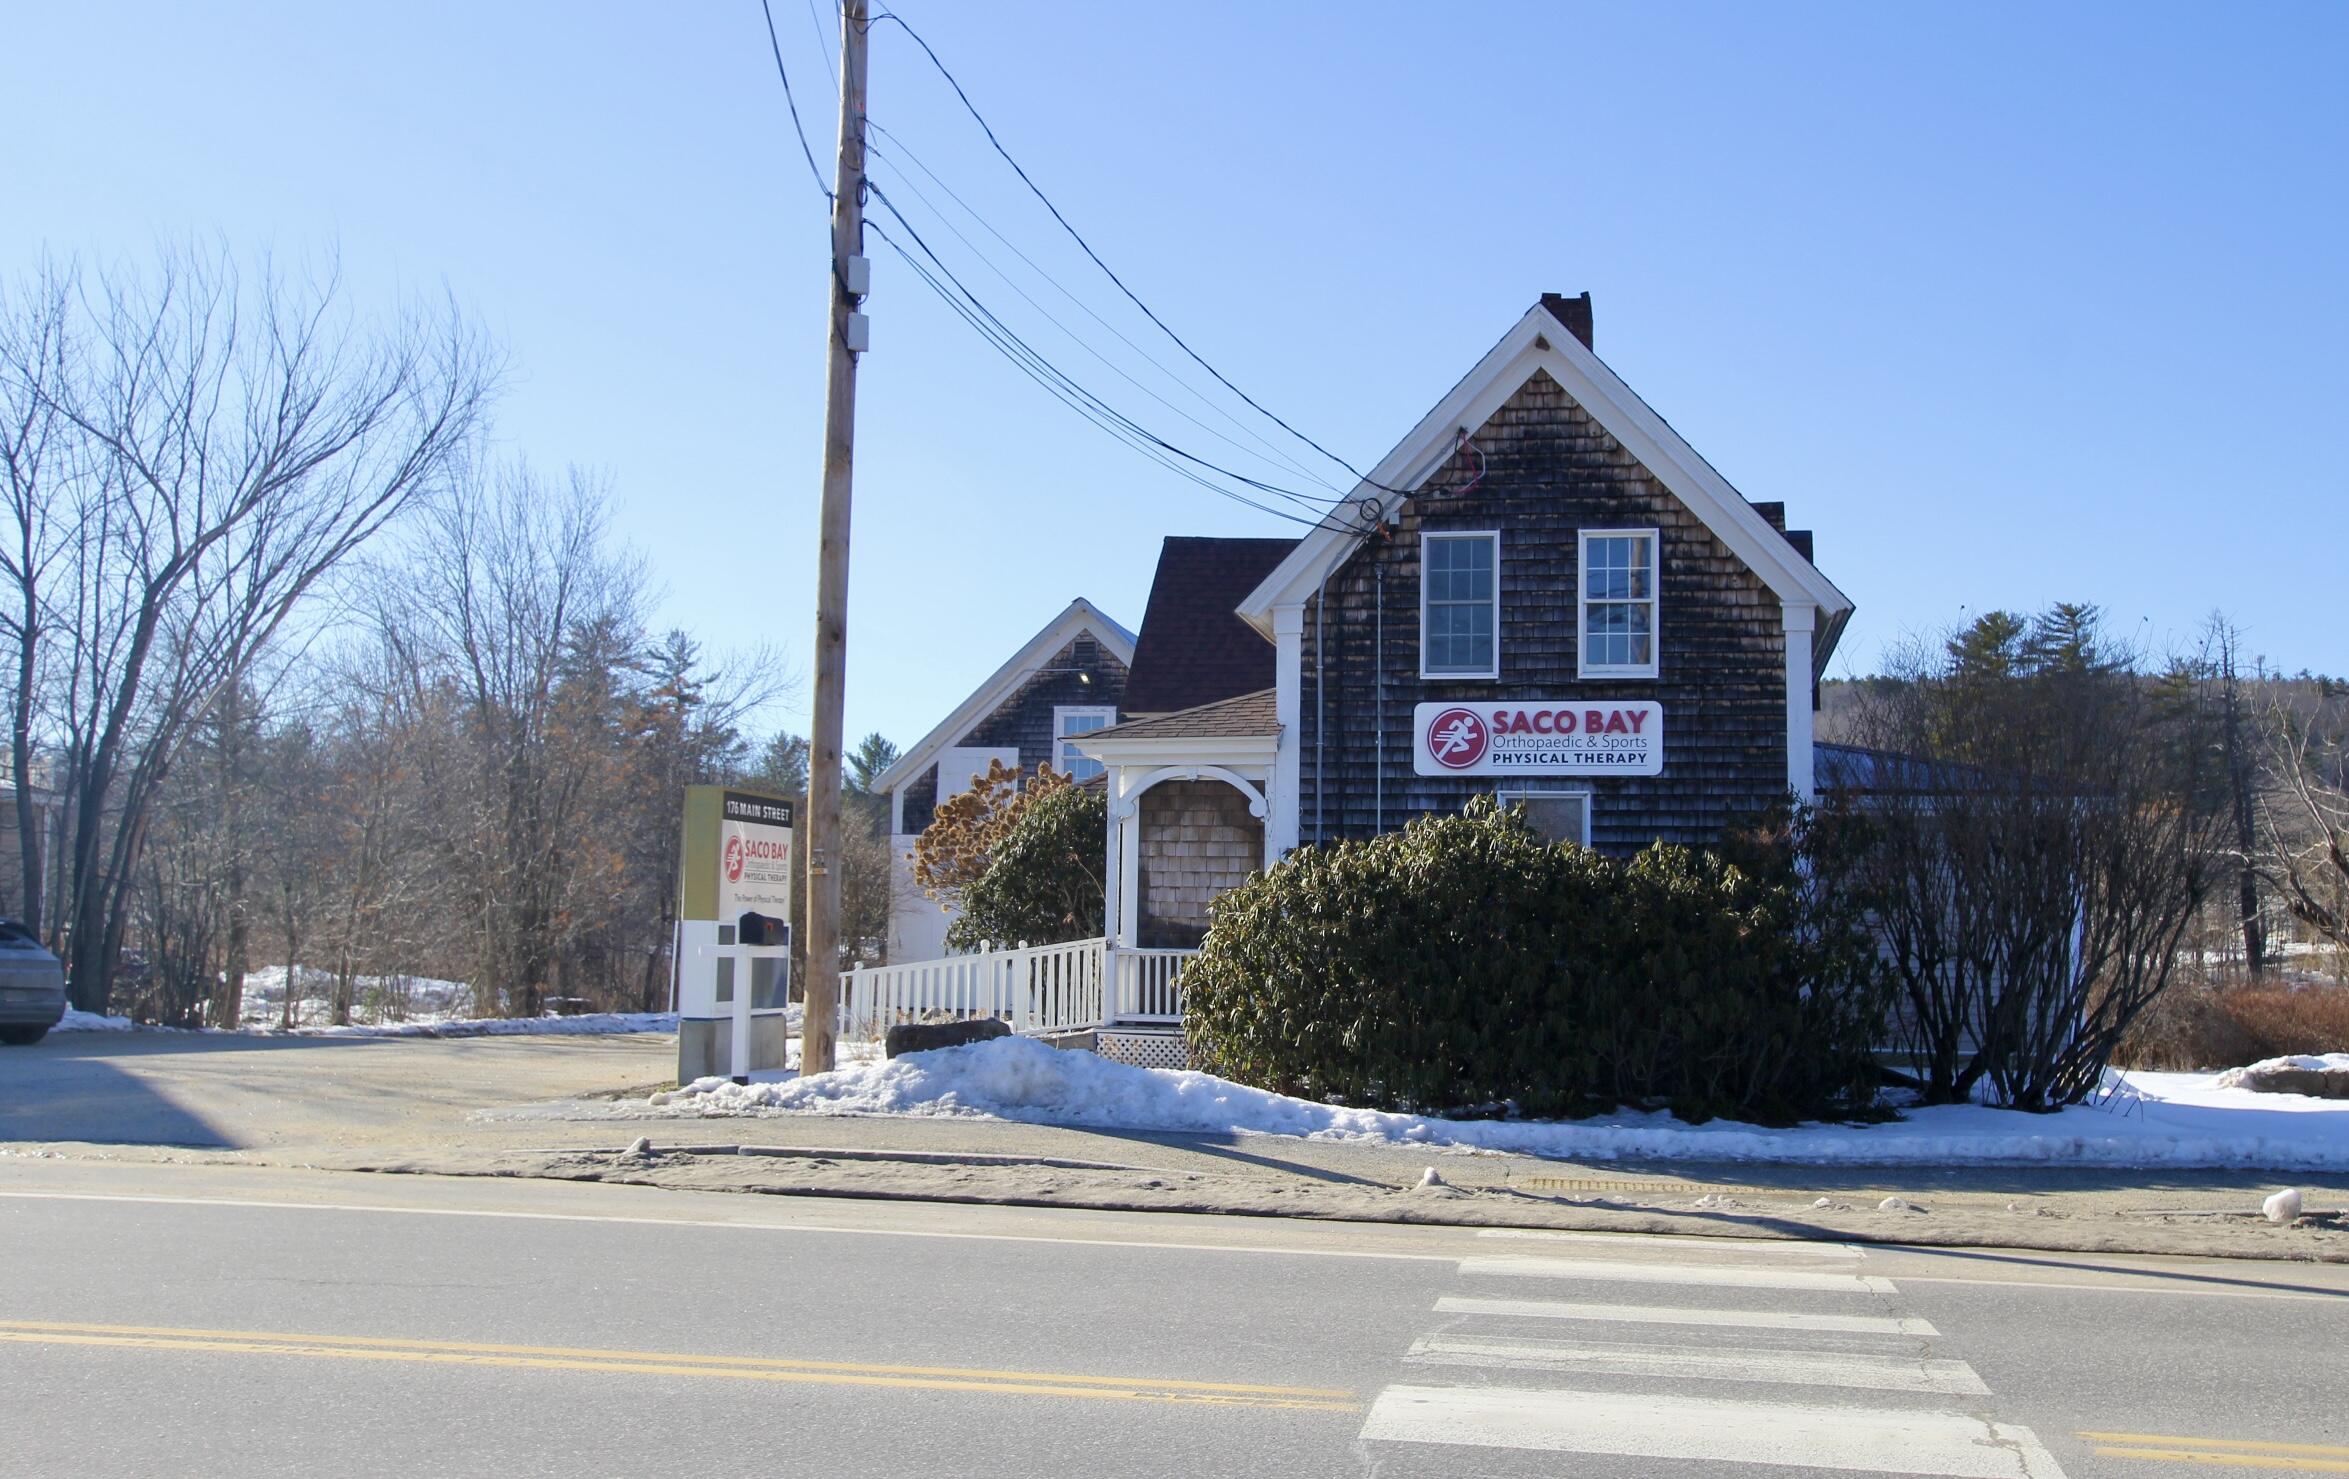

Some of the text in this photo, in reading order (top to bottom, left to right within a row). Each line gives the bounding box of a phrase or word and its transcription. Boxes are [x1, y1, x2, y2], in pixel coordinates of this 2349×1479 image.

[1492, 710, 1649, 734] SACO BAY
[1493, 735, 1648, 751] Orthopaedic & Sports
[1493, 753, 1648, 764] PHYSICAL THERAPY
[727, 800, 790, 822] 176 MAIN STREET
[745, 839, 789, 860] SACO BAY
[744, 871, 767, 881] PHYSICAL
